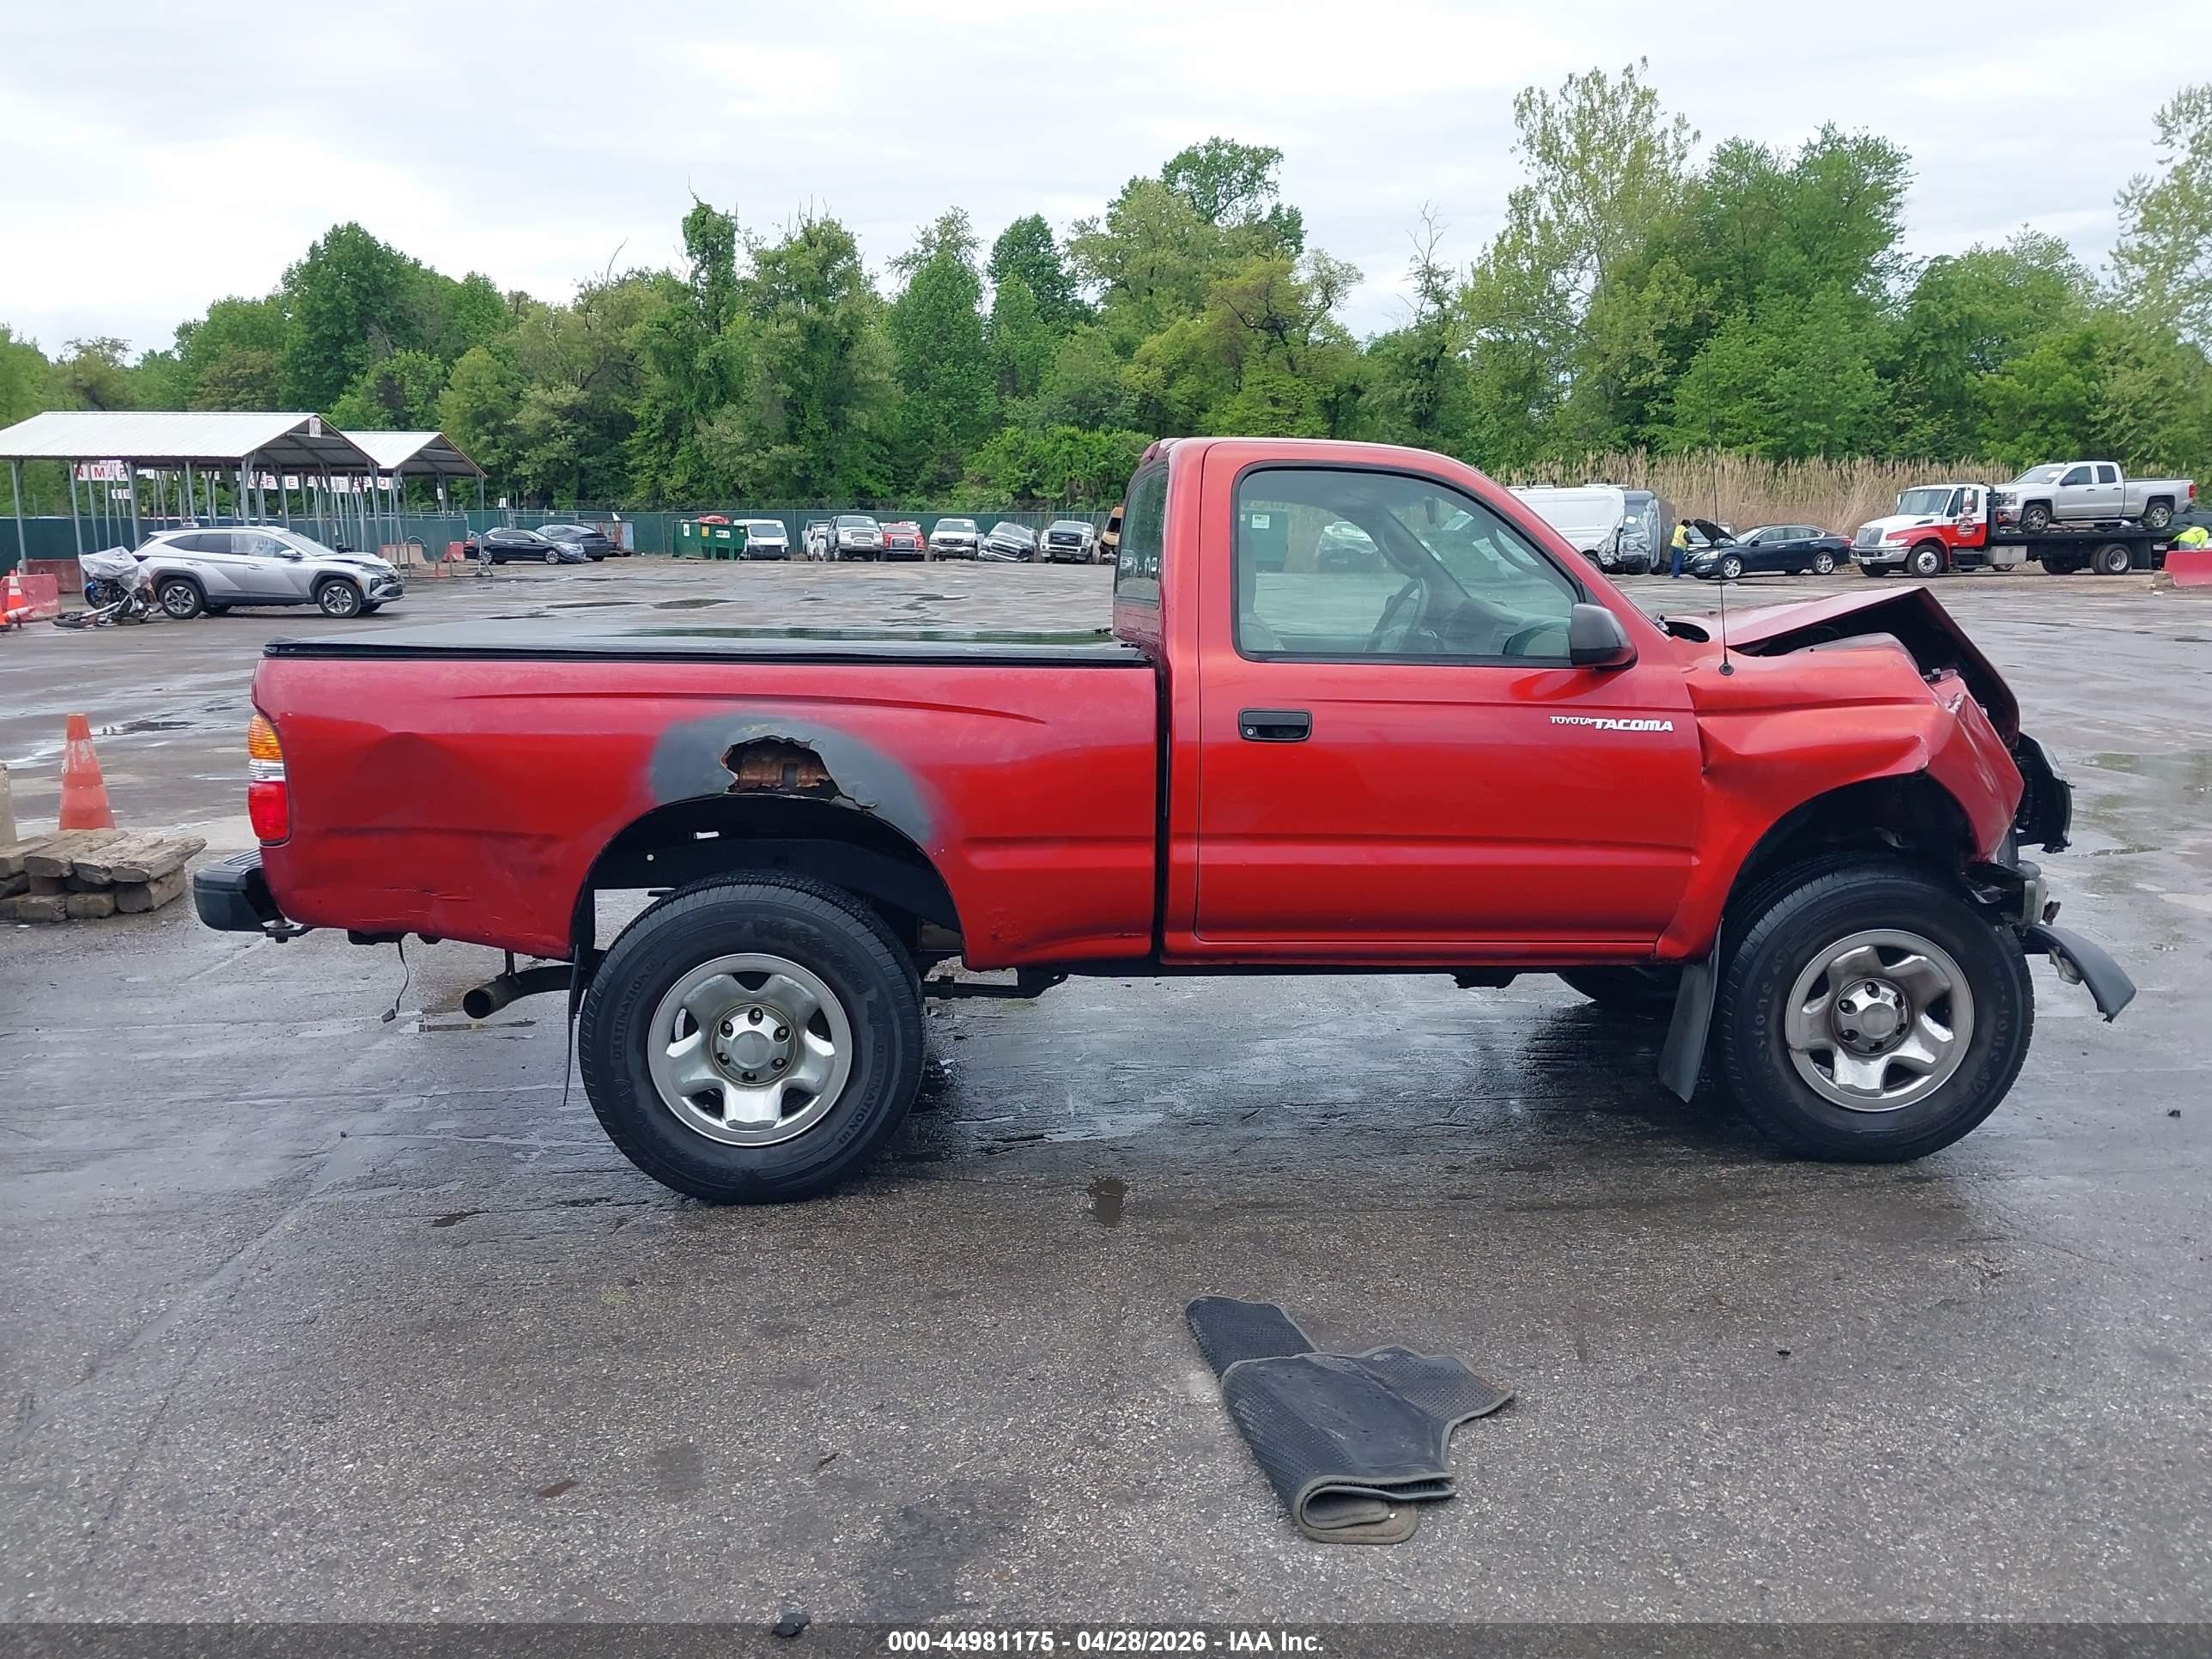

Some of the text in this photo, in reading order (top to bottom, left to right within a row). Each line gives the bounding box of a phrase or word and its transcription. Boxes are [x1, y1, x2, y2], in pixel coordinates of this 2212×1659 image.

[94, 466, 106, 478] M
[288, 477, 296, 487] E
[1549, 715, 1674, 732] TOYOTA TACOMA
